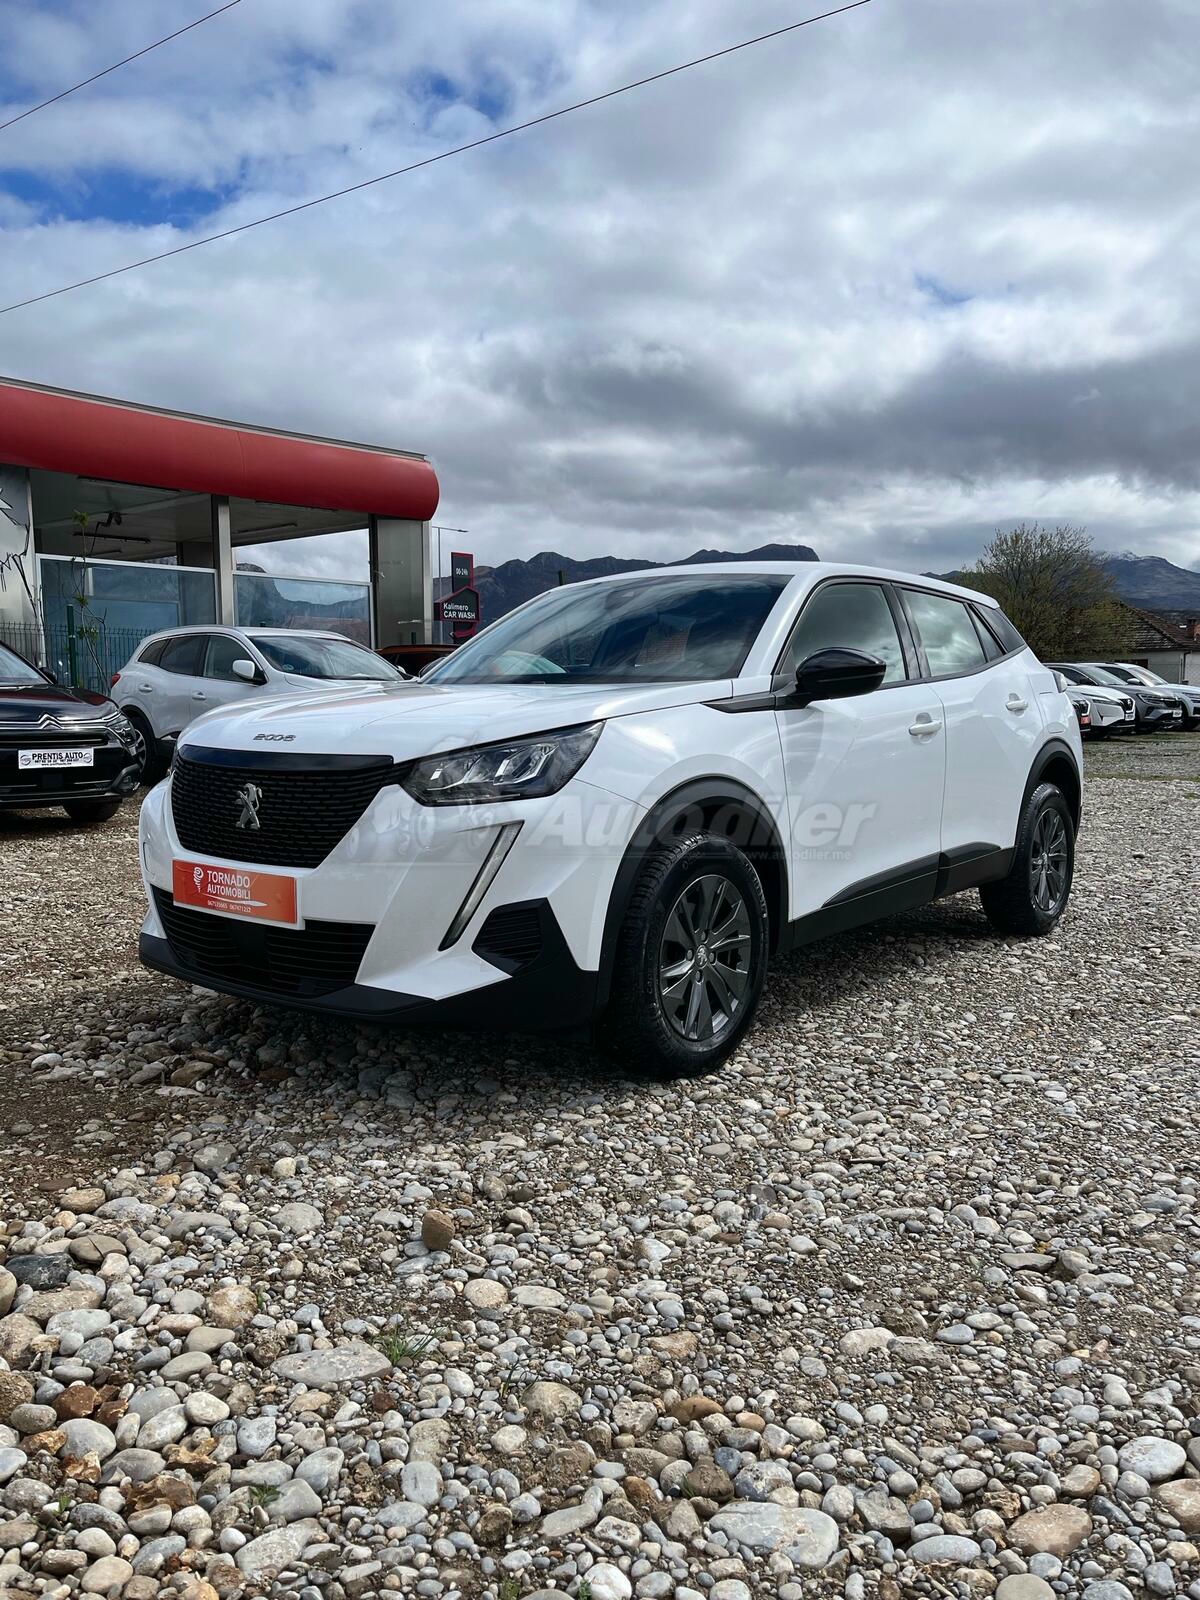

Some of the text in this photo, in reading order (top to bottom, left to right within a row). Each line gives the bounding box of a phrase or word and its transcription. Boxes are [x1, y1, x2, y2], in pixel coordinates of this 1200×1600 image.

[443, 603, 468, 611] Kalimero
[458, 611, 475, 619] WASH
[253, 733, 296, 742] 2008
[207, 870, 250, 887] TORNADO
[207, 885, 250, 899] AUTOMOBILI
